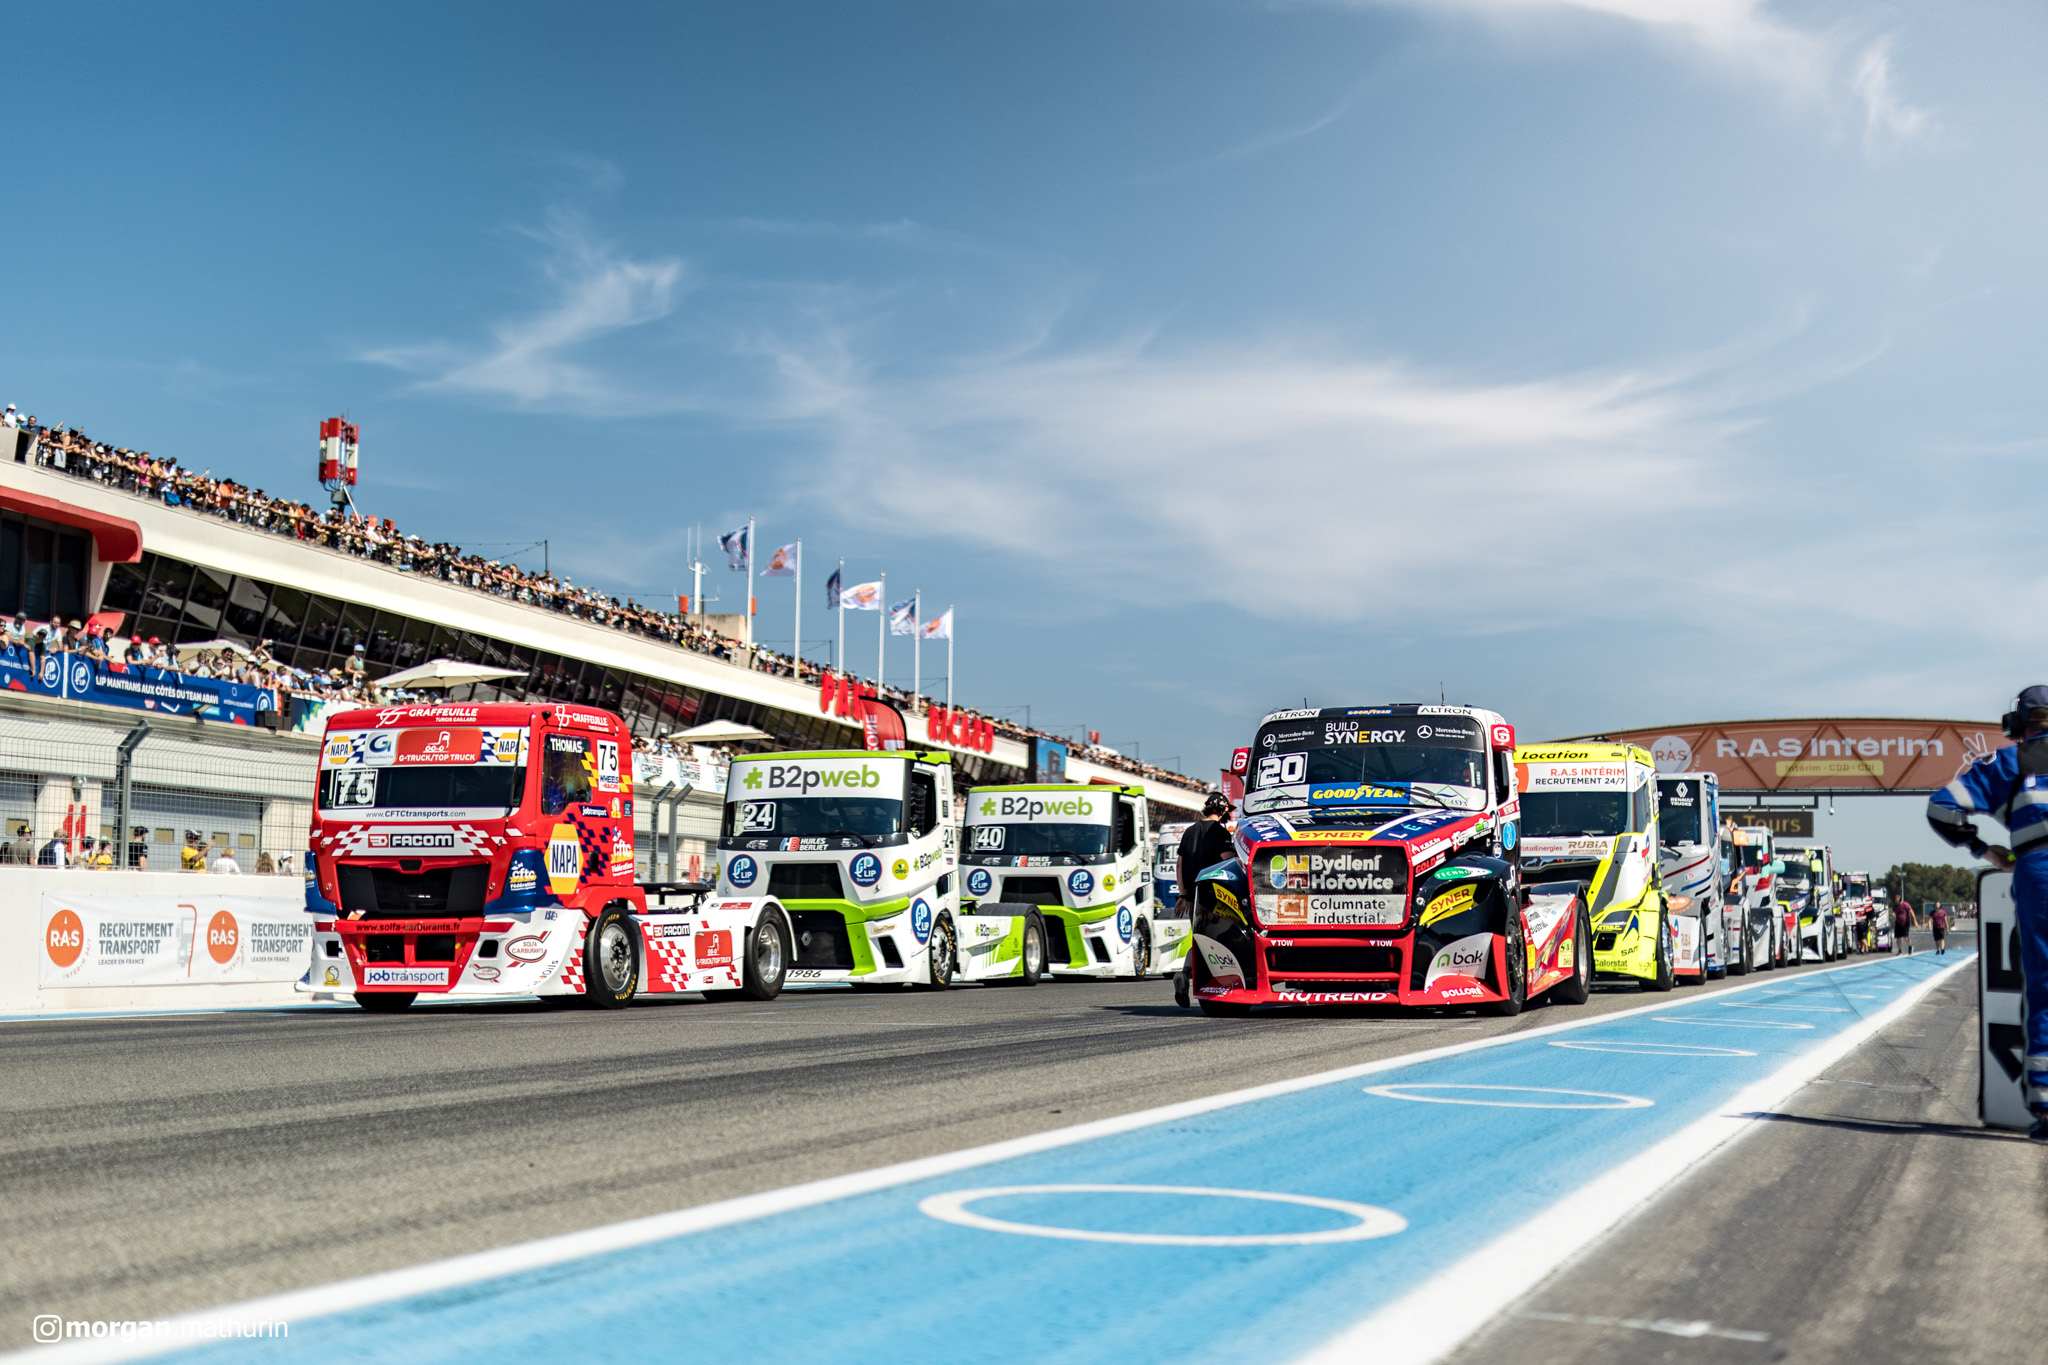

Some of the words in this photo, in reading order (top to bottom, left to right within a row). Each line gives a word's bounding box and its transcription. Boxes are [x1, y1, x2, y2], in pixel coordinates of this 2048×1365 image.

[95, 676, 106, 687] LIP
[106, 676, 142, 693] MANTRANS
[141, 683, 155, 695] AUX
[176, 689, 185, 699] DU
[185, 690, 202, 702] TEAM
[409, 708, 478, 717] GRAFFEUILLE
[1270, 710, 1317, 720] ALTRON
[1420, 707, 1472, 716] ALTRON
[572, 713, 608, 726] GRAFFEUILLE
[928, 704, 994, 754] RICARD
[1325, 722, 1359, 732] BUILD
[1435, 727, 1475, 736] Mercedes-Benz
[1278, 730, 1315, 739] Mercedes-Benz
[330, 744, 349, 756] NAPA
[499, 740, 520, 754] NAPA
[550, 738, 583, 753] THOMAS
[1716, 738, 1802, 758] R.A.S
[1812, 736, 1944, 756] Intérim
[399, 754, 450, 762] G-TRUCK/TOP
[450, 754, 476, 762] TRUCK
[600, 744, 618, 772] 75
[1522, 750, 1589, 761] Location
[1260, 754, 1305, 787] 20
[1550, 768, 1578, 776] R.A.S
[1581, 766, 1625, 776] INTÉRIM
[1786, 764, 1821, 772] Intérim
[1829, 764, 1849, 772] CDD
[769, 764, 880, 795] B2pweb
[1536, 778, 1602, 786] RECRUTEMENT
[337, 772, 376, 804] 75
[1312, 783, 1405, 800] GOODYEAR
[366, 810, 466, 819] www.CFTCtransports.com
[743, 804, 772, 827] 24
[1001, 796, 1094, 821] B2pweb
[1744, 814, 1801, 832] Tours
[392, 834, 453, 848] FACOM
[944, 828, 954, 849] 24
[977, 828, 1002, 847] 40
[613, 840, 632, 858] cftc
[552, 845, 578, 874] NAPA
[920, 846, 942, 871] B2pweb
[1311, 854, 1383, 875] Bydlení
[1415, 857, 1436, 874] GOLD
[512, 866, 536, 880] cftc
[1080, 882, 1090, 890] LIP
[1311, 874, 1394, 890] Hořovice
[1310, 898, 1386, 910] Columnate
[1430, 888, 1470, 914] SYNER
[100, 922, 174, 938] RECRUTEMENT
[252, 923, 314, 937] RECRUTEMENT
[356, 922, 460, 932] www.solfa-carburants.fr
[664, 924, 690, 937] FACOM
[921, 922, 929, 932] LIP
[99, 940, 161, 955] TRANSPORT
[251, 940, 304, 953] TRANSPORT
[512, 946, 544, 954] CARBURANTS
[98, 958, 118, 966] LEADER
[1216, 953, 1235, 966] bak
[1453, 950, 1483, 966] bak
[1594, 959, 1628, 967] Calorstat
[368, 968, 445, 983] jobtransport
[788, 970, 822, 978] 1986
[1278, 992, 1388, 1002] NUTREND
[1441, 986, 1483, 999] BOLLORÉ
